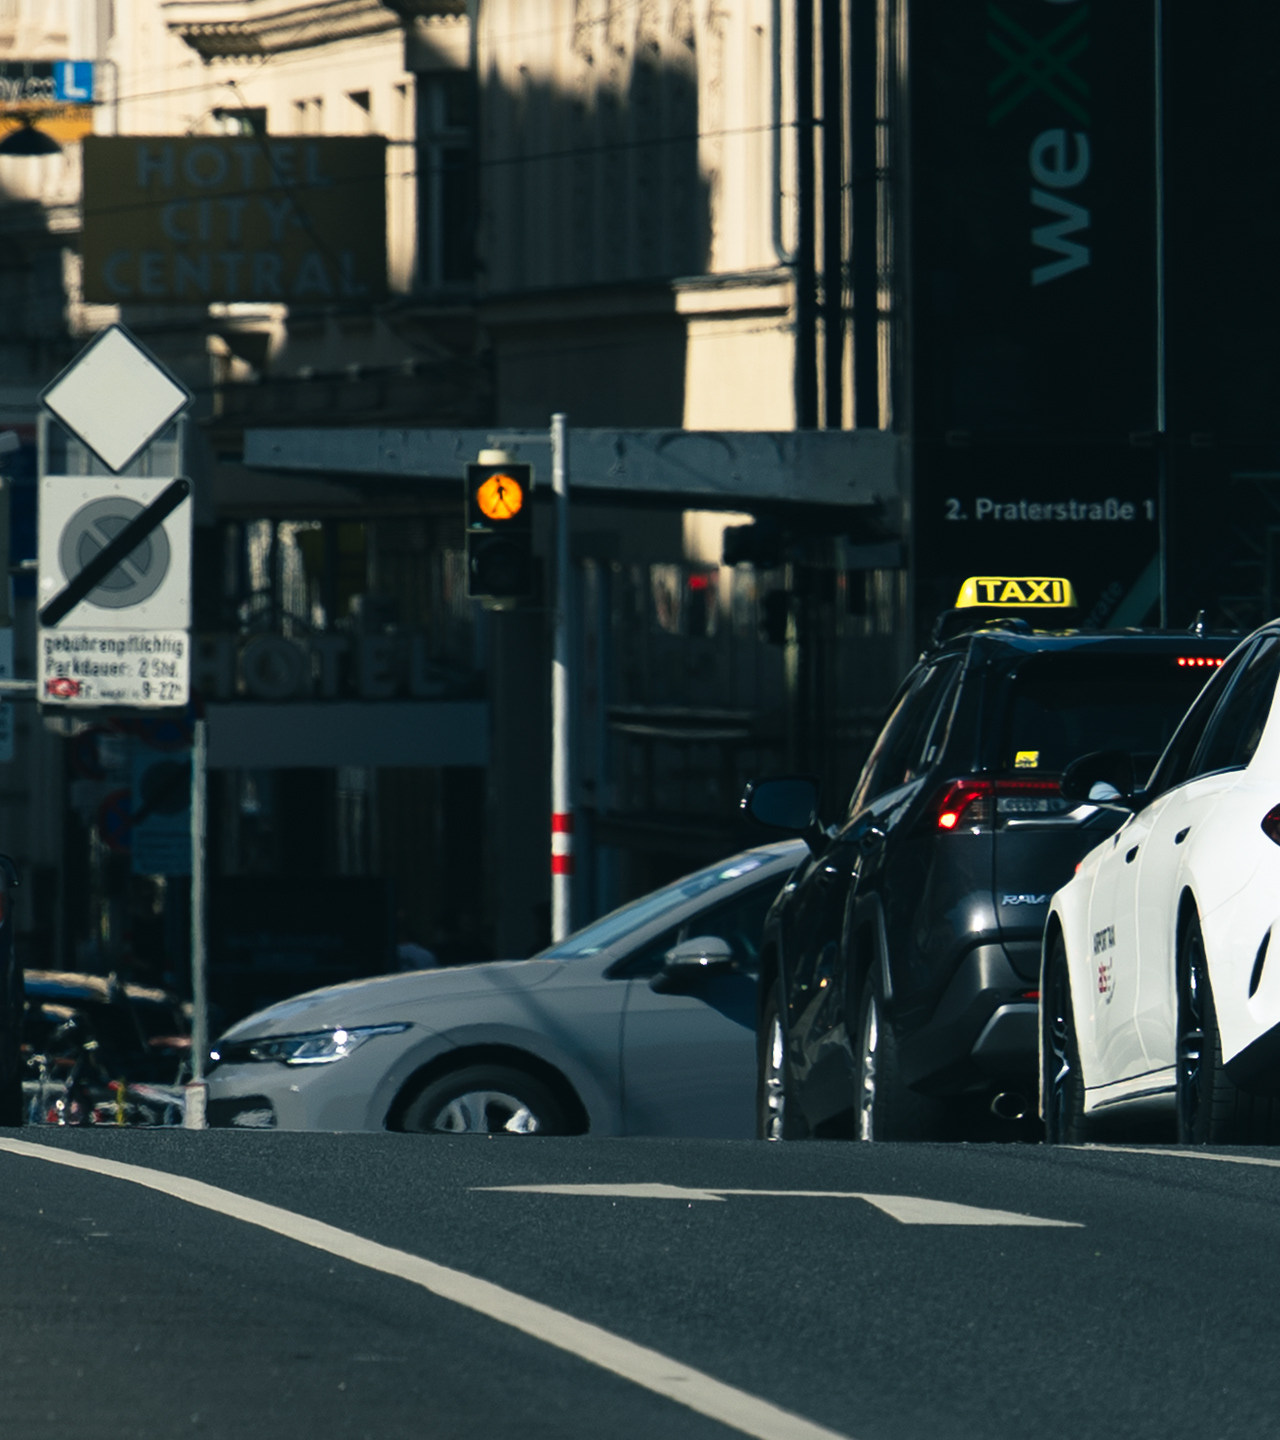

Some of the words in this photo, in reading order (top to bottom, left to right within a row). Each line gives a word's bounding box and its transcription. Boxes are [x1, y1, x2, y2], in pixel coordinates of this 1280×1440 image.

[137, 144, 336, 189] HOTEL
[101, 250, 370, 297] CENTRAL
[944, 497, 968, 521] 2.
[975, 496, 1135, 521] Praterstraße
[1142, 498, 1155, 521] 1
[978, 580, 1062, 602] TAXI
[193, 633, 446, 700] HOTEL
